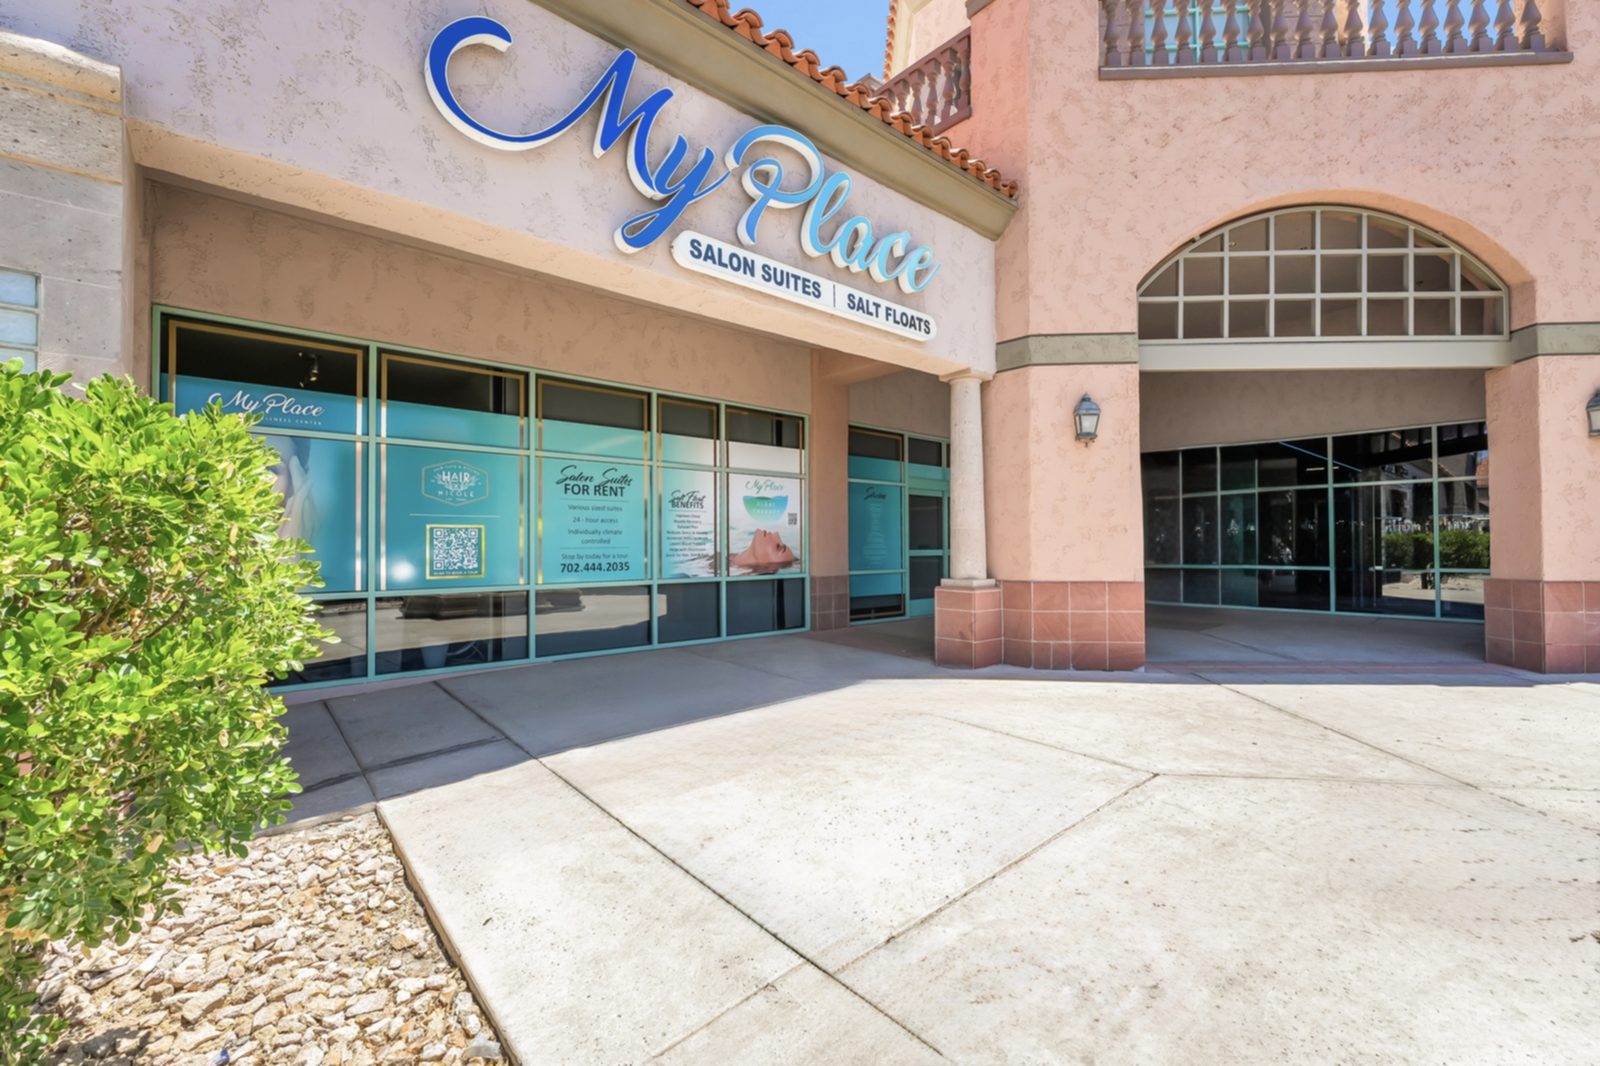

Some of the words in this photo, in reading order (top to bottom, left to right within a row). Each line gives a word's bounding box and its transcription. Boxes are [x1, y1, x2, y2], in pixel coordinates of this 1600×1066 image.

[424, 16, 731, 254] My
[724, 125, 942, 294] Place
[689, 238, 756, 278] SALON
[761, 259, 822, 299] SUITES
[847, 293, 881, 318] SALT
[885, 306, 932, 336] FLOATS
[263, 393, 326, 417] Place
[441, 470, 470, 482] HAIR
[555, 464, 594, 485] Salon
[599, 467, 633, 487] Suites
[564, 483, 590, 495] FOR
[594, 485, 625, 497] RENT
[745, 479, 763, 494] My
[437, 490, 475, 498] NICOLE
[671, 501, 704, 510] BENEFITS
[576, 553, 584, 561] by
[585, 552, 601, 560] today
[560, 561, 630, 573] 702.444.2035
